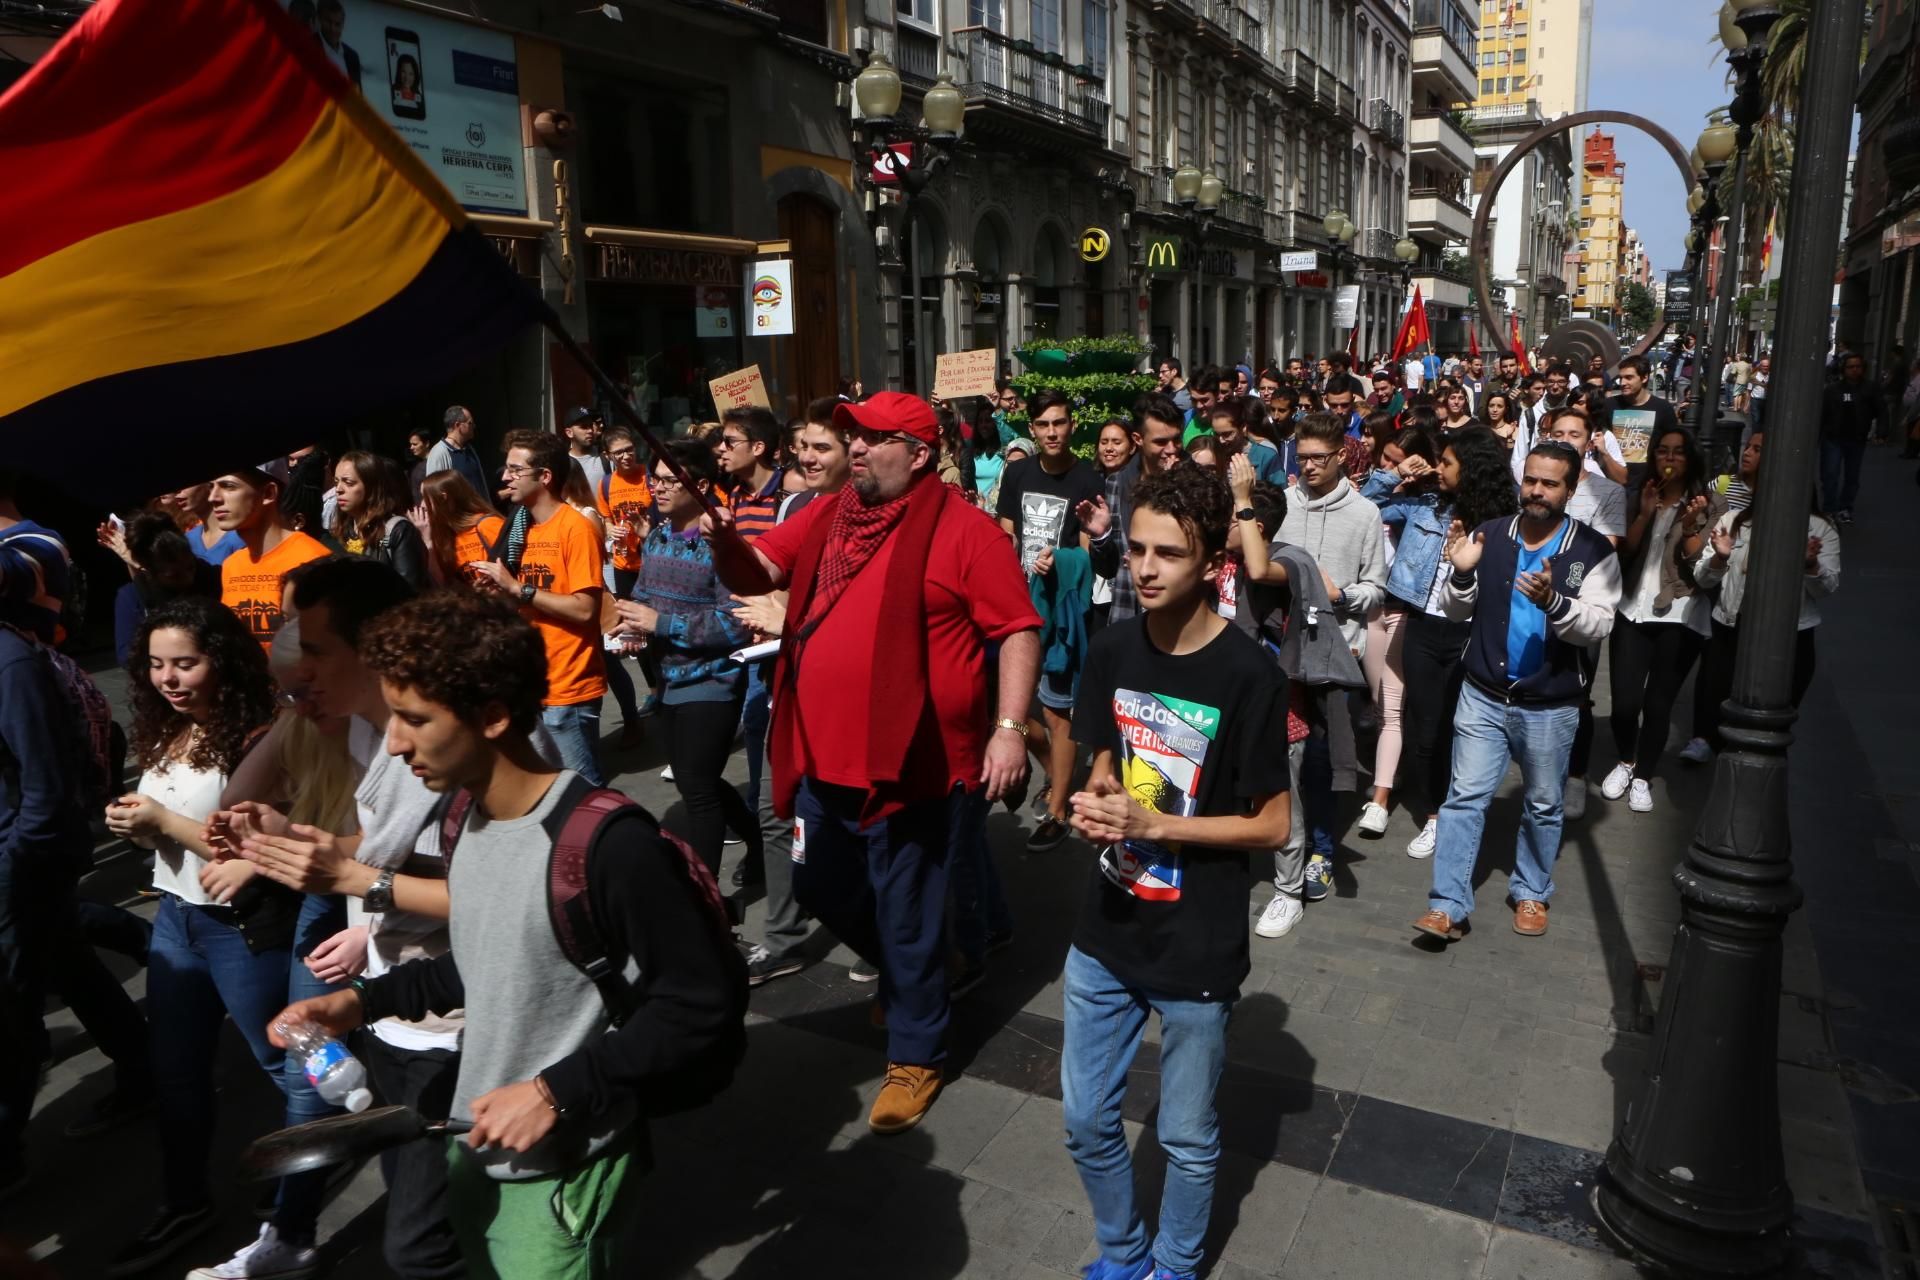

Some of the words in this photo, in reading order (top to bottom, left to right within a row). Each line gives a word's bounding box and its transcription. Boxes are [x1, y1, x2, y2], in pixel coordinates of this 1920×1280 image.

[492, 66, 515, 81] First
[442, 155, 485, 170] HERRERA
[486, 162, 514, 173] CERPA
[1623, 417, 1643, 429] MY
[1622, 428, 1644, 439] LIFE
[1023, 526, 1056, 540] adidas
[1114, 697, 1180, 728] adidas
